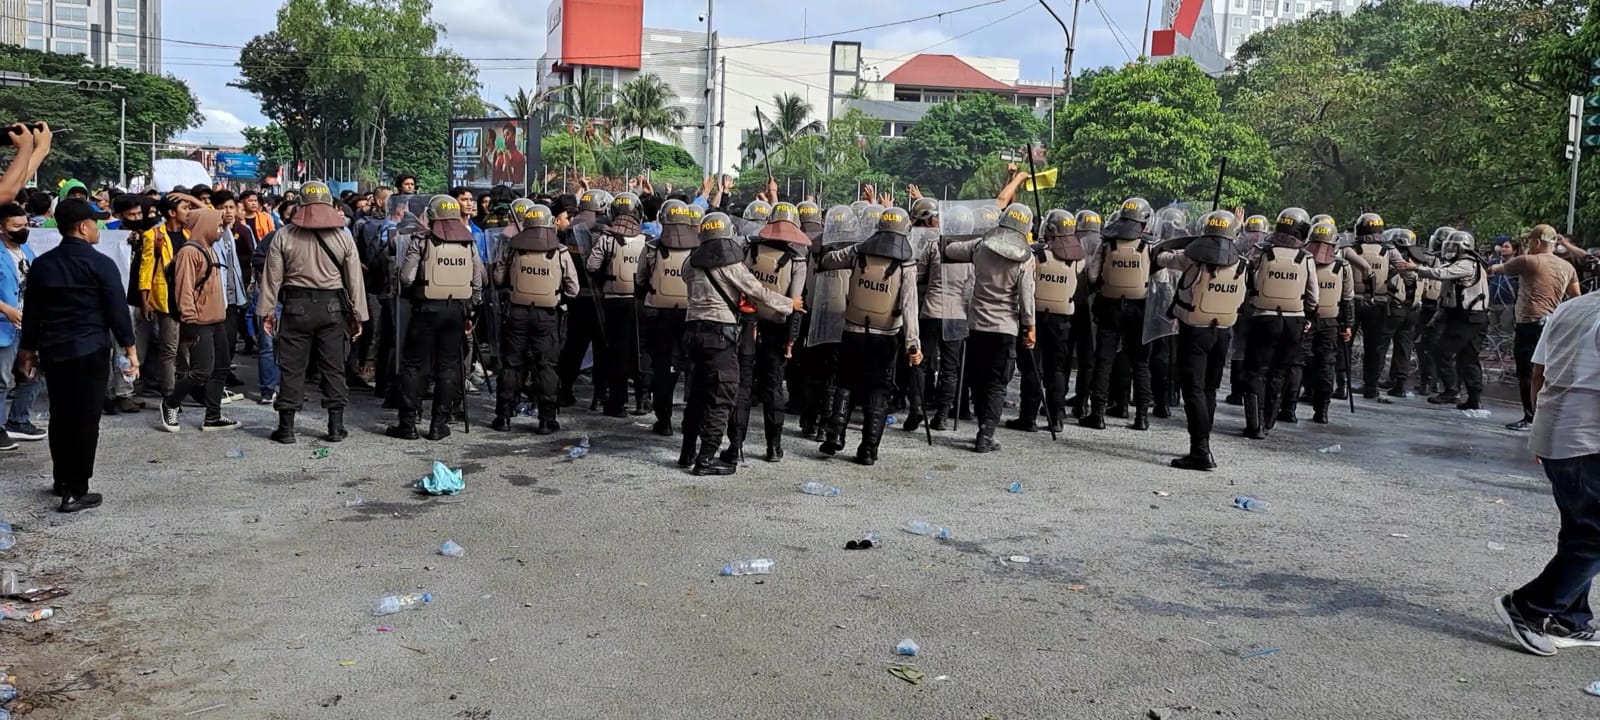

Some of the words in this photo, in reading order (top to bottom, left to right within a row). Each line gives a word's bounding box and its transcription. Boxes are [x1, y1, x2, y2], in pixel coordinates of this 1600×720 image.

[437, 257, 466, 266] POLISI
[1112, 260, 1140, 269] POLISI
[520, 266, 550, 276] POLISI
[1268, 270, 1298, 281] POLISI
[1040, 273, 1067, 284] POLISI
[858, 278, 889, 293] POLISI
[1208, 283, 1238, 293] POLISI
